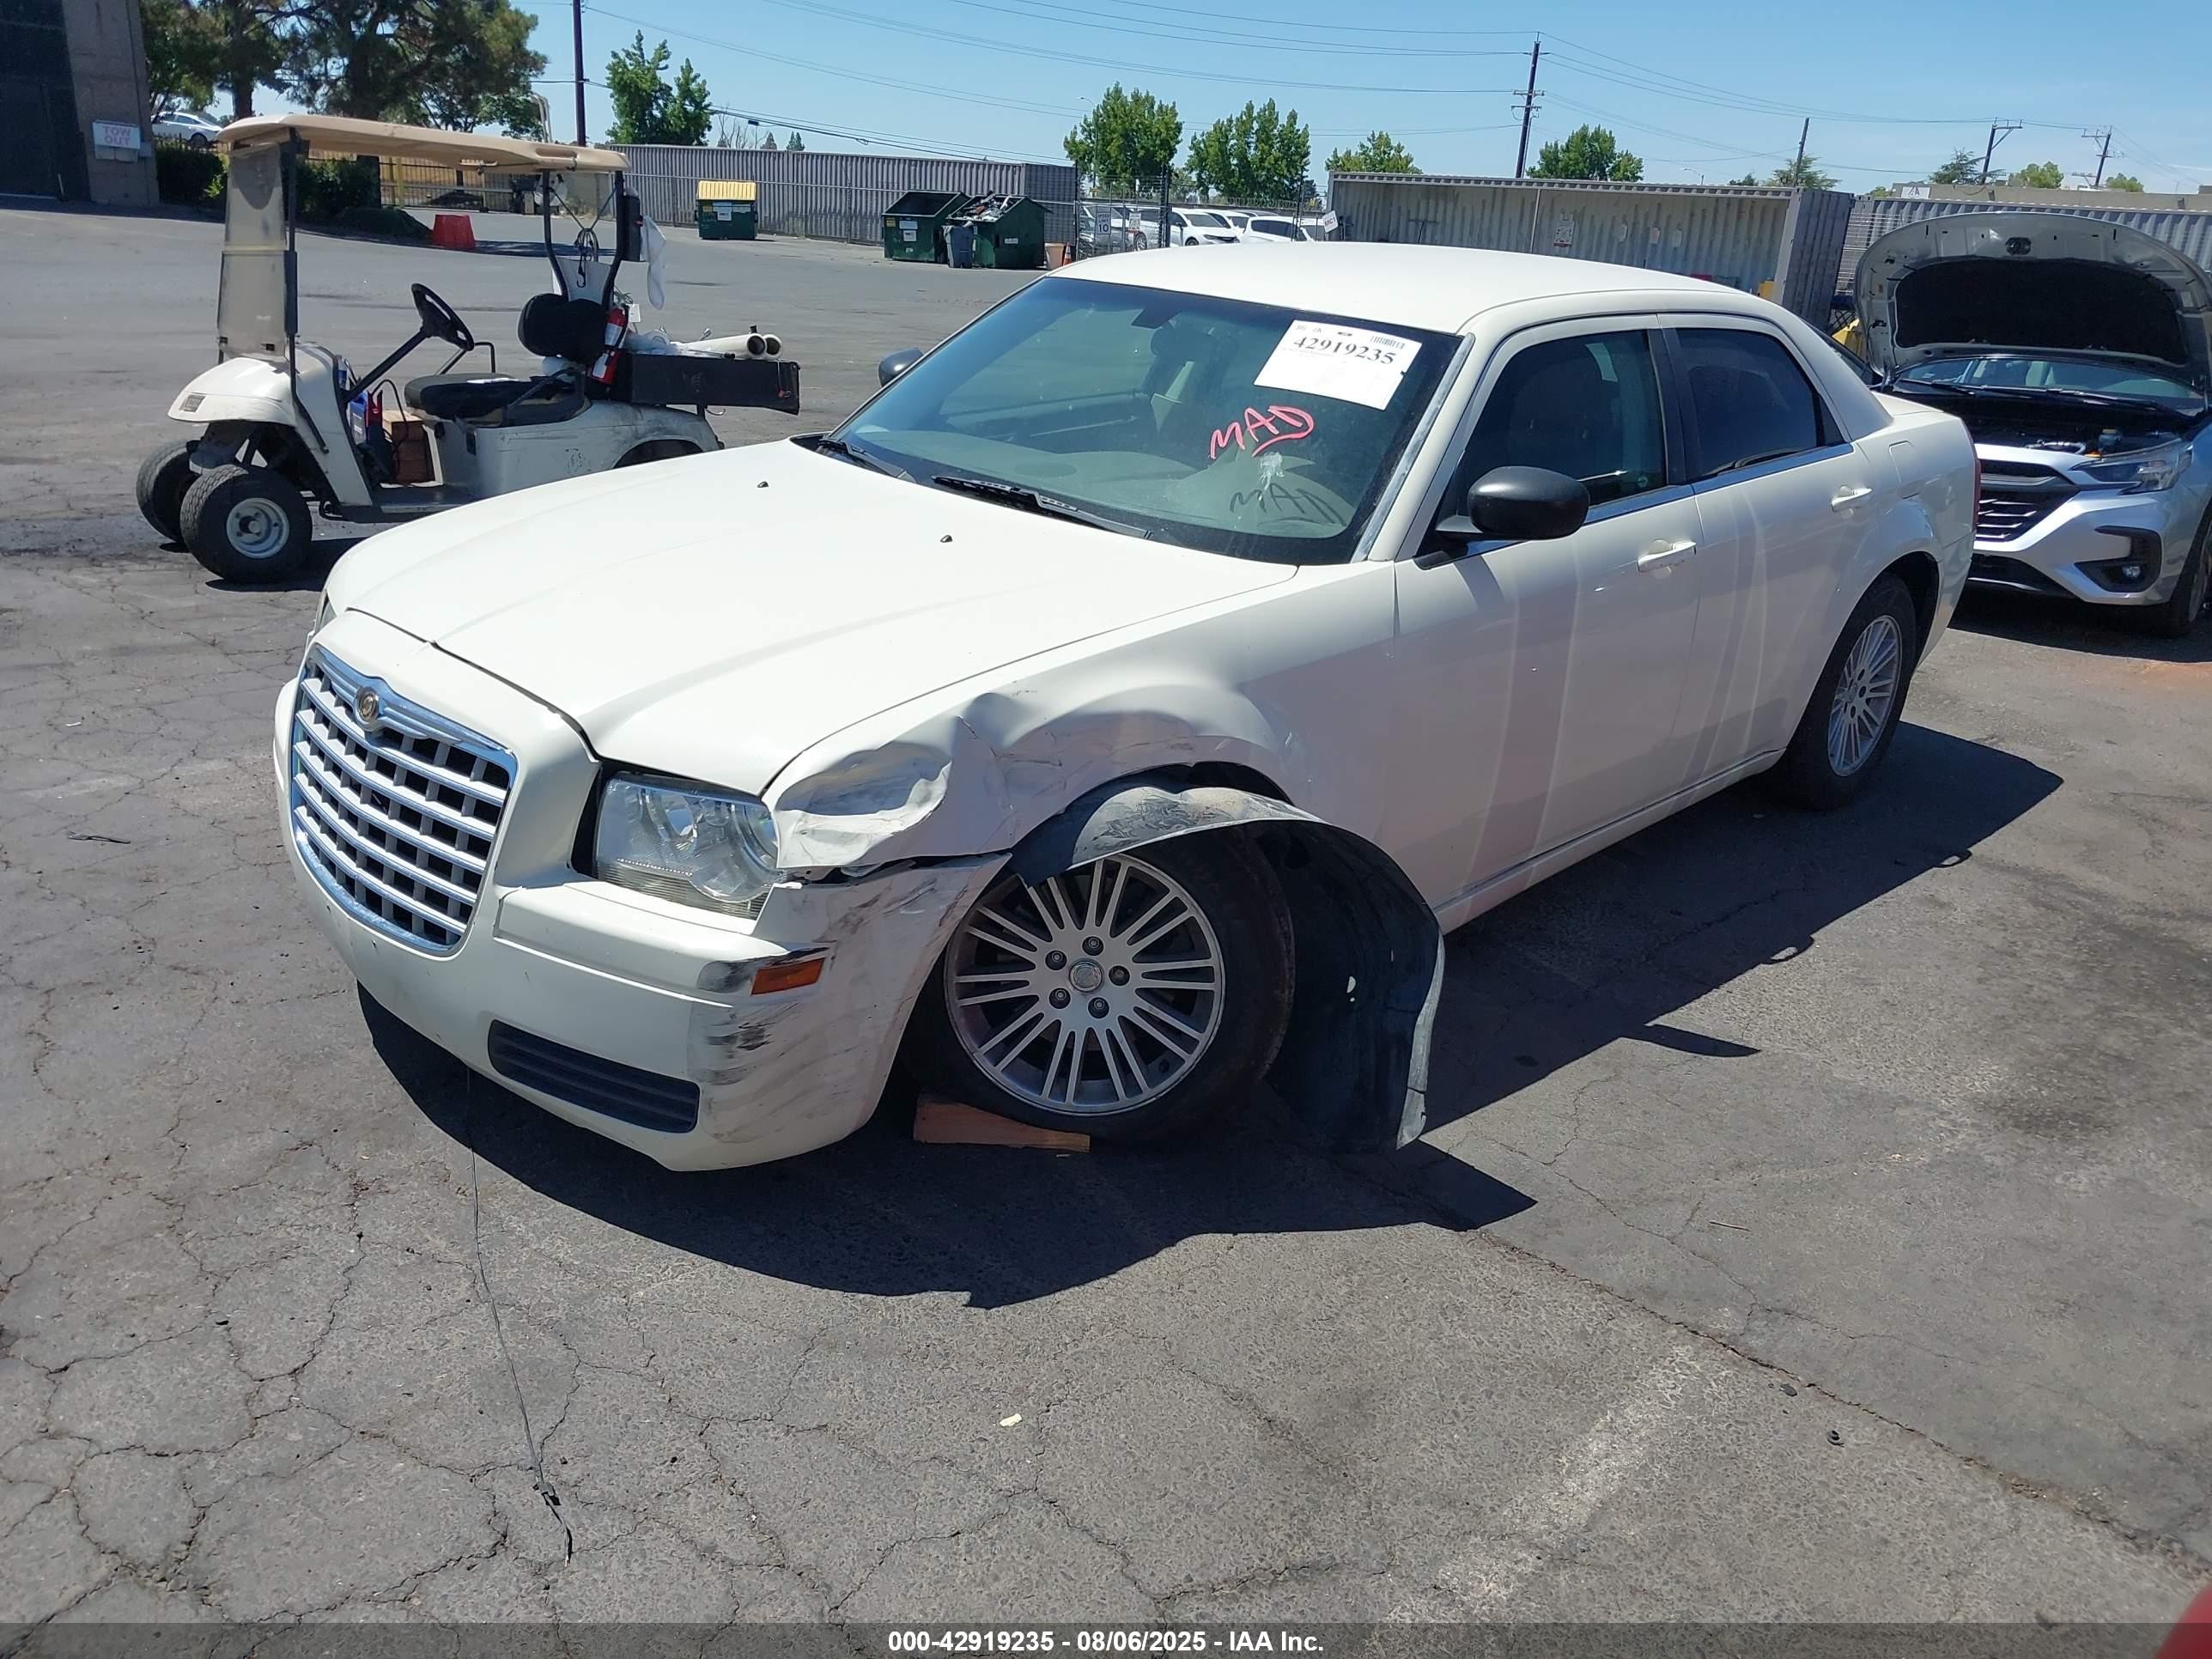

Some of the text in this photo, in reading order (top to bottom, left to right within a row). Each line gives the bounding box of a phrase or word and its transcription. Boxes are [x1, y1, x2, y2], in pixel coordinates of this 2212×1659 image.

[102, 125, 131, 137] TOW
[104, 135, 131, 145] OUT
[1099, 224, 1109, 233] 10
[1294, 336, 1397, 365] 42919235
[1208, 405, 1315, 459] MAD
